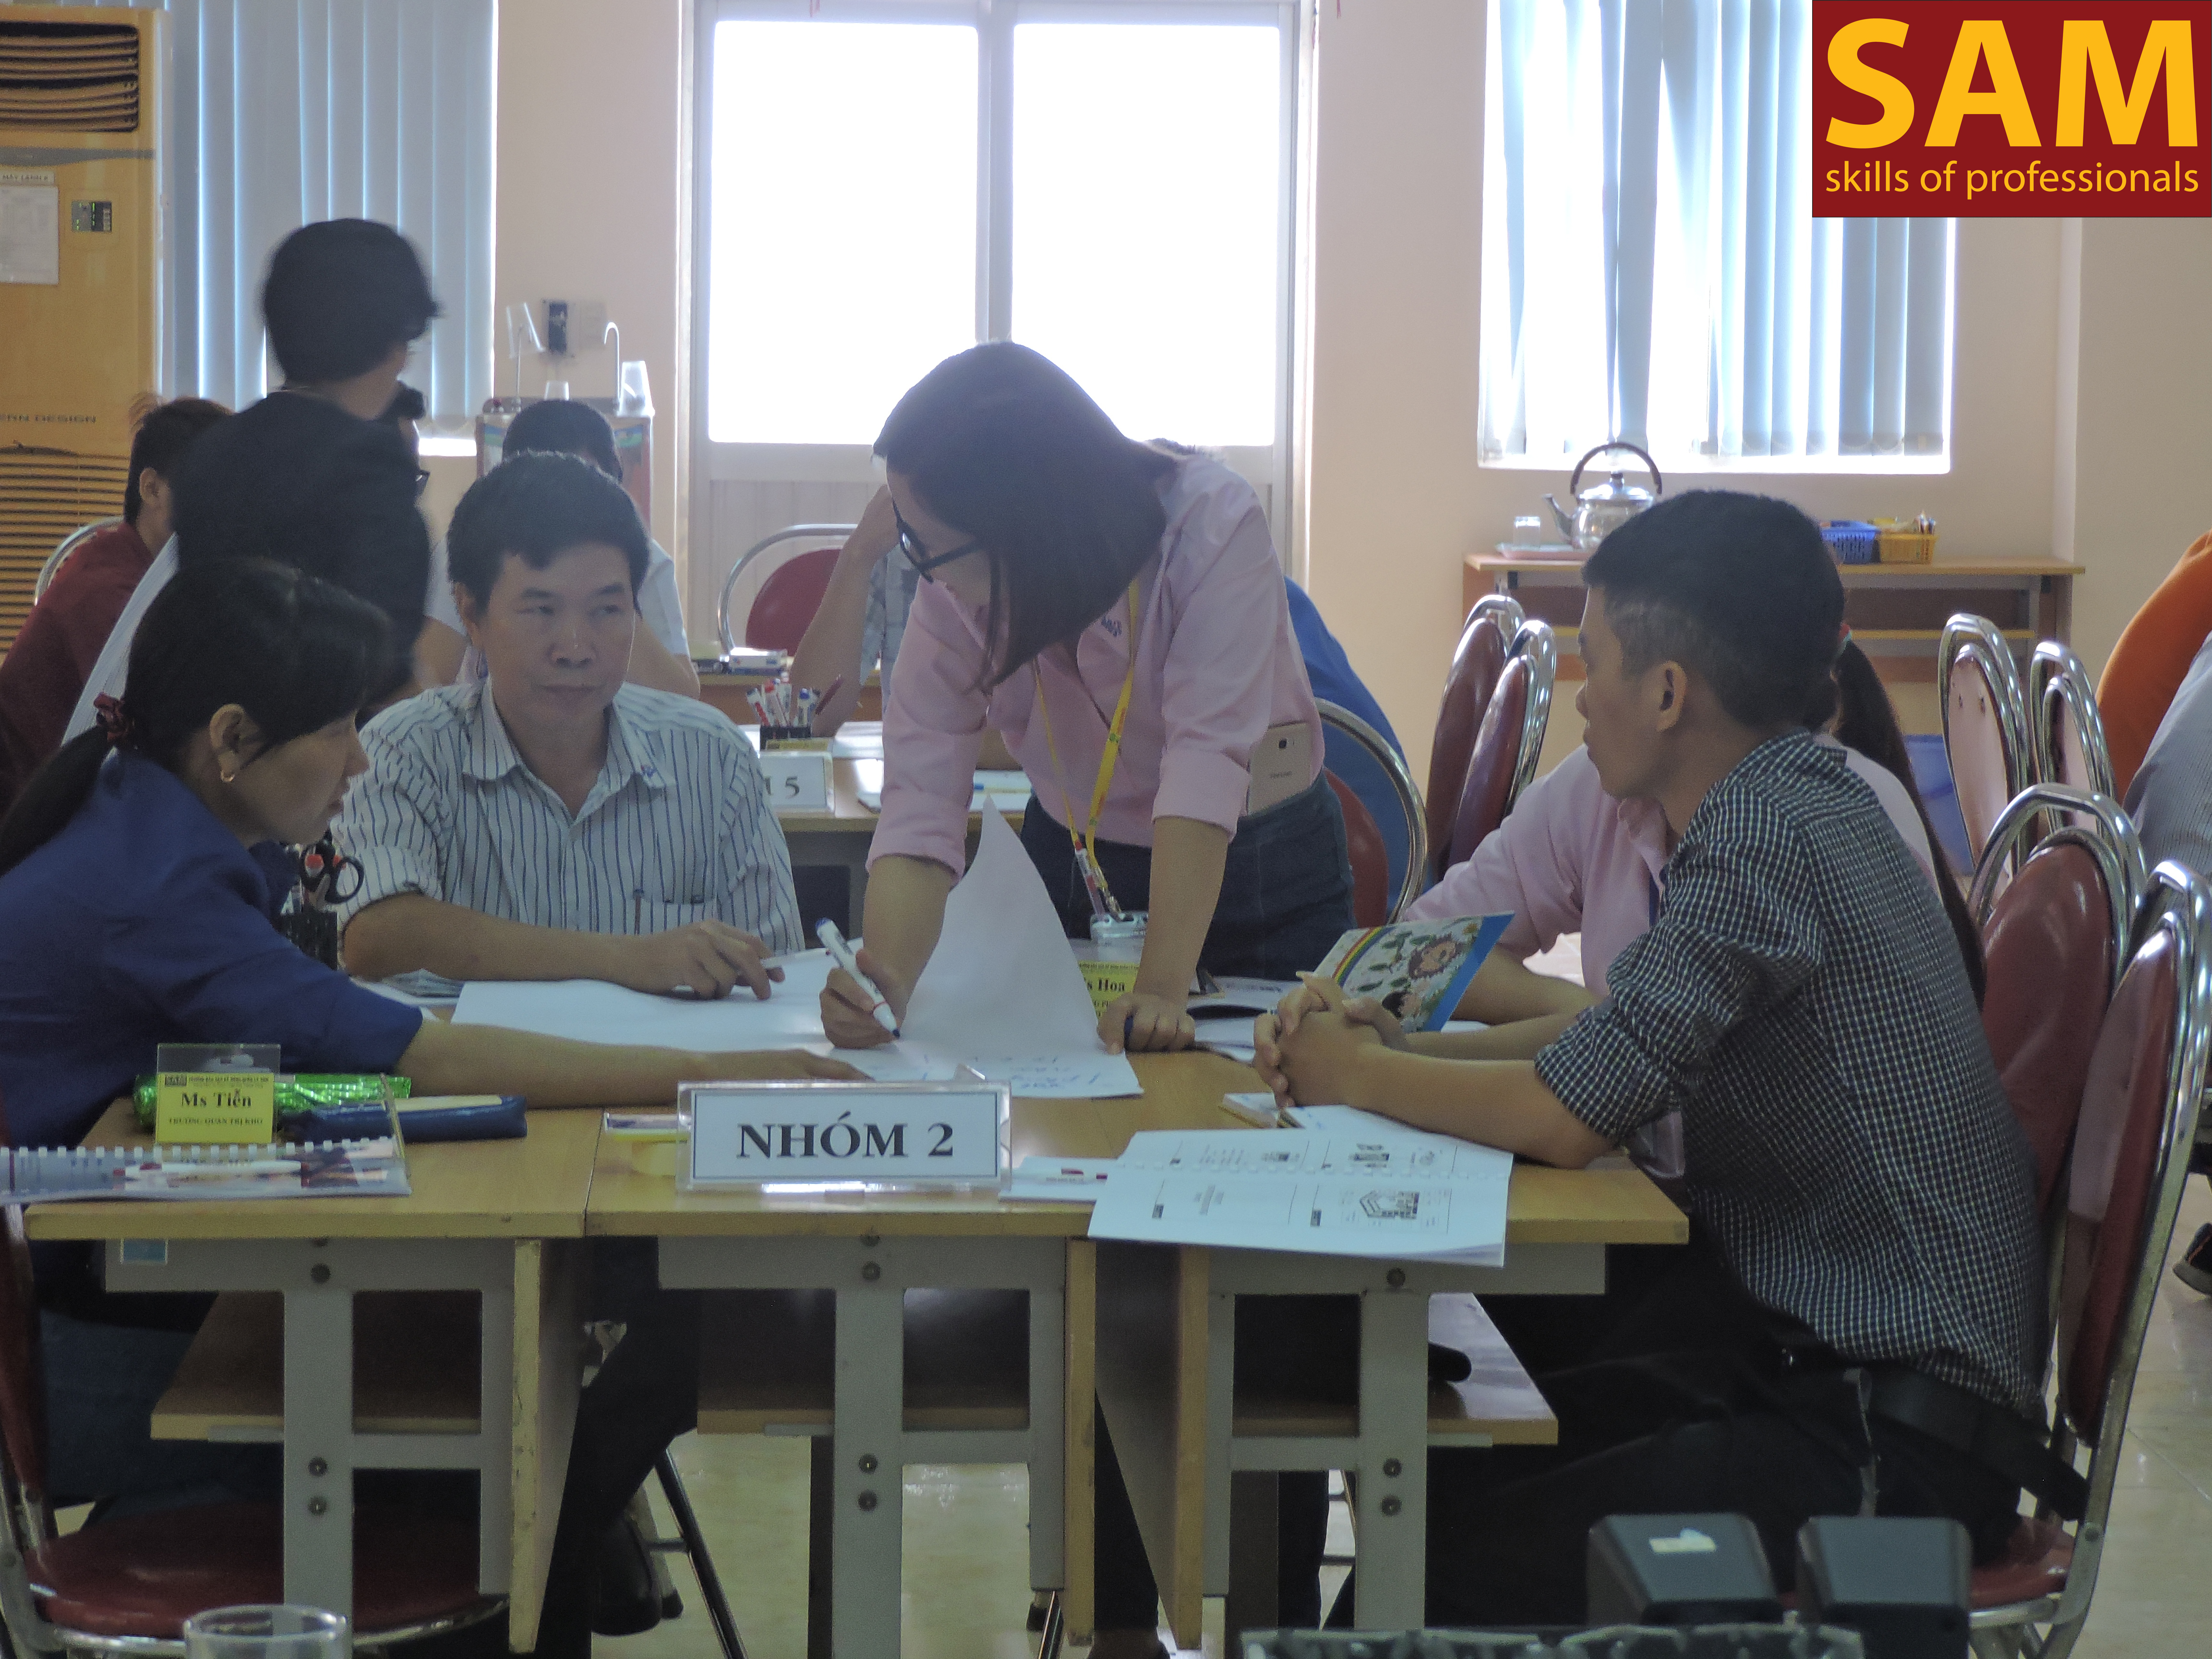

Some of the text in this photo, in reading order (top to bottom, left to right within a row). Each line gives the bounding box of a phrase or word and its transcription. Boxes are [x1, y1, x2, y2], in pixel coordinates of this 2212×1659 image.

[785, 776, 800, 799] 5
[1098, 977, 1125, 992] Hoa
[181, 1092, 207, 1107] Ms
[736, 1109, 954, 1158] NHÓM 2
